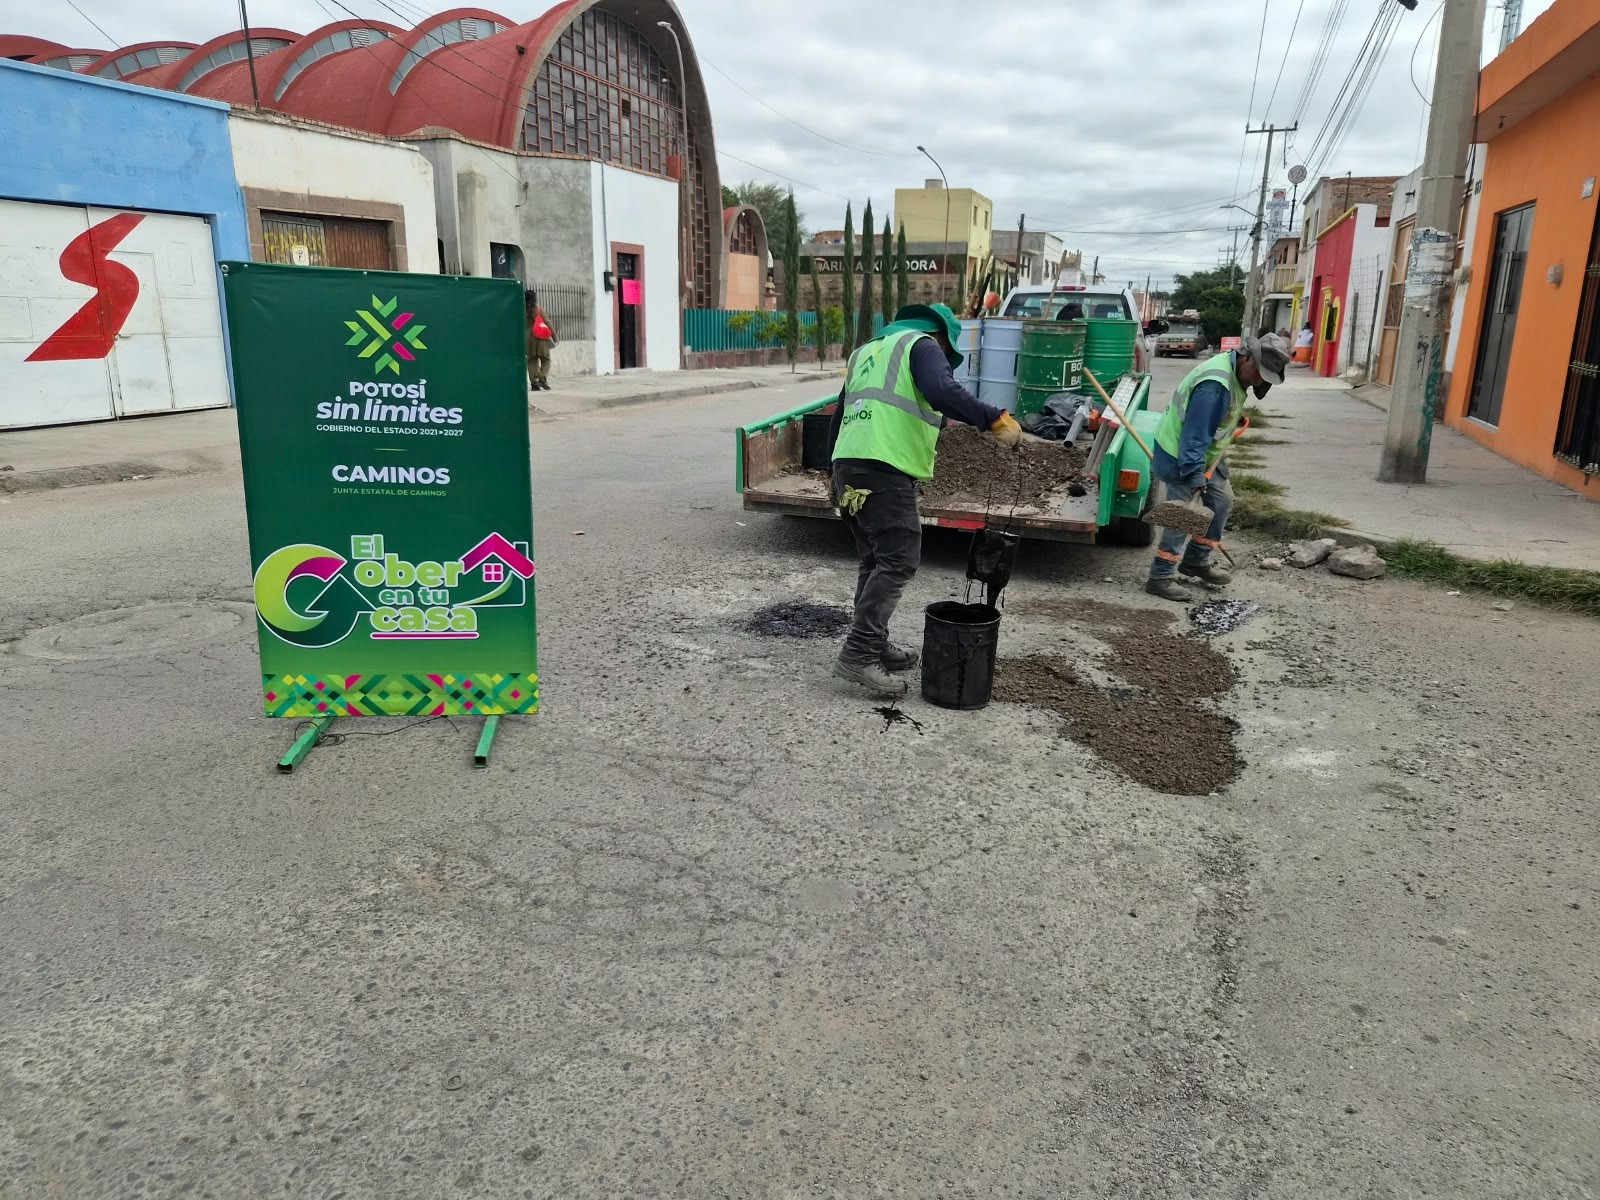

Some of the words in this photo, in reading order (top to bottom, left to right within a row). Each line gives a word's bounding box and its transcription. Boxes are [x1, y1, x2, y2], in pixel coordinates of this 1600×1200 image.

[815, 260, 848, 272] ARI
[855, 260, 937, 271] AXIADORA
[316, 395, 360, 420] sin
[843, 410, 872, 425] CAOS
[316, 424, 363, 433] GOBIERNO
[364, 426, 383, 434] DEL
[383, 427, 418, 435] ESTADO
[331, 464, 451, 485] CAMINOS
[361, 488, 394, 496] ESTATAL
[409, 489, 447, 497] CAMINOS
[351, 534, 384, 560] El
[378, 588, 414, 605] en
[418, 586, 449, 605] tu
[370, 606, 478, 632] casa
